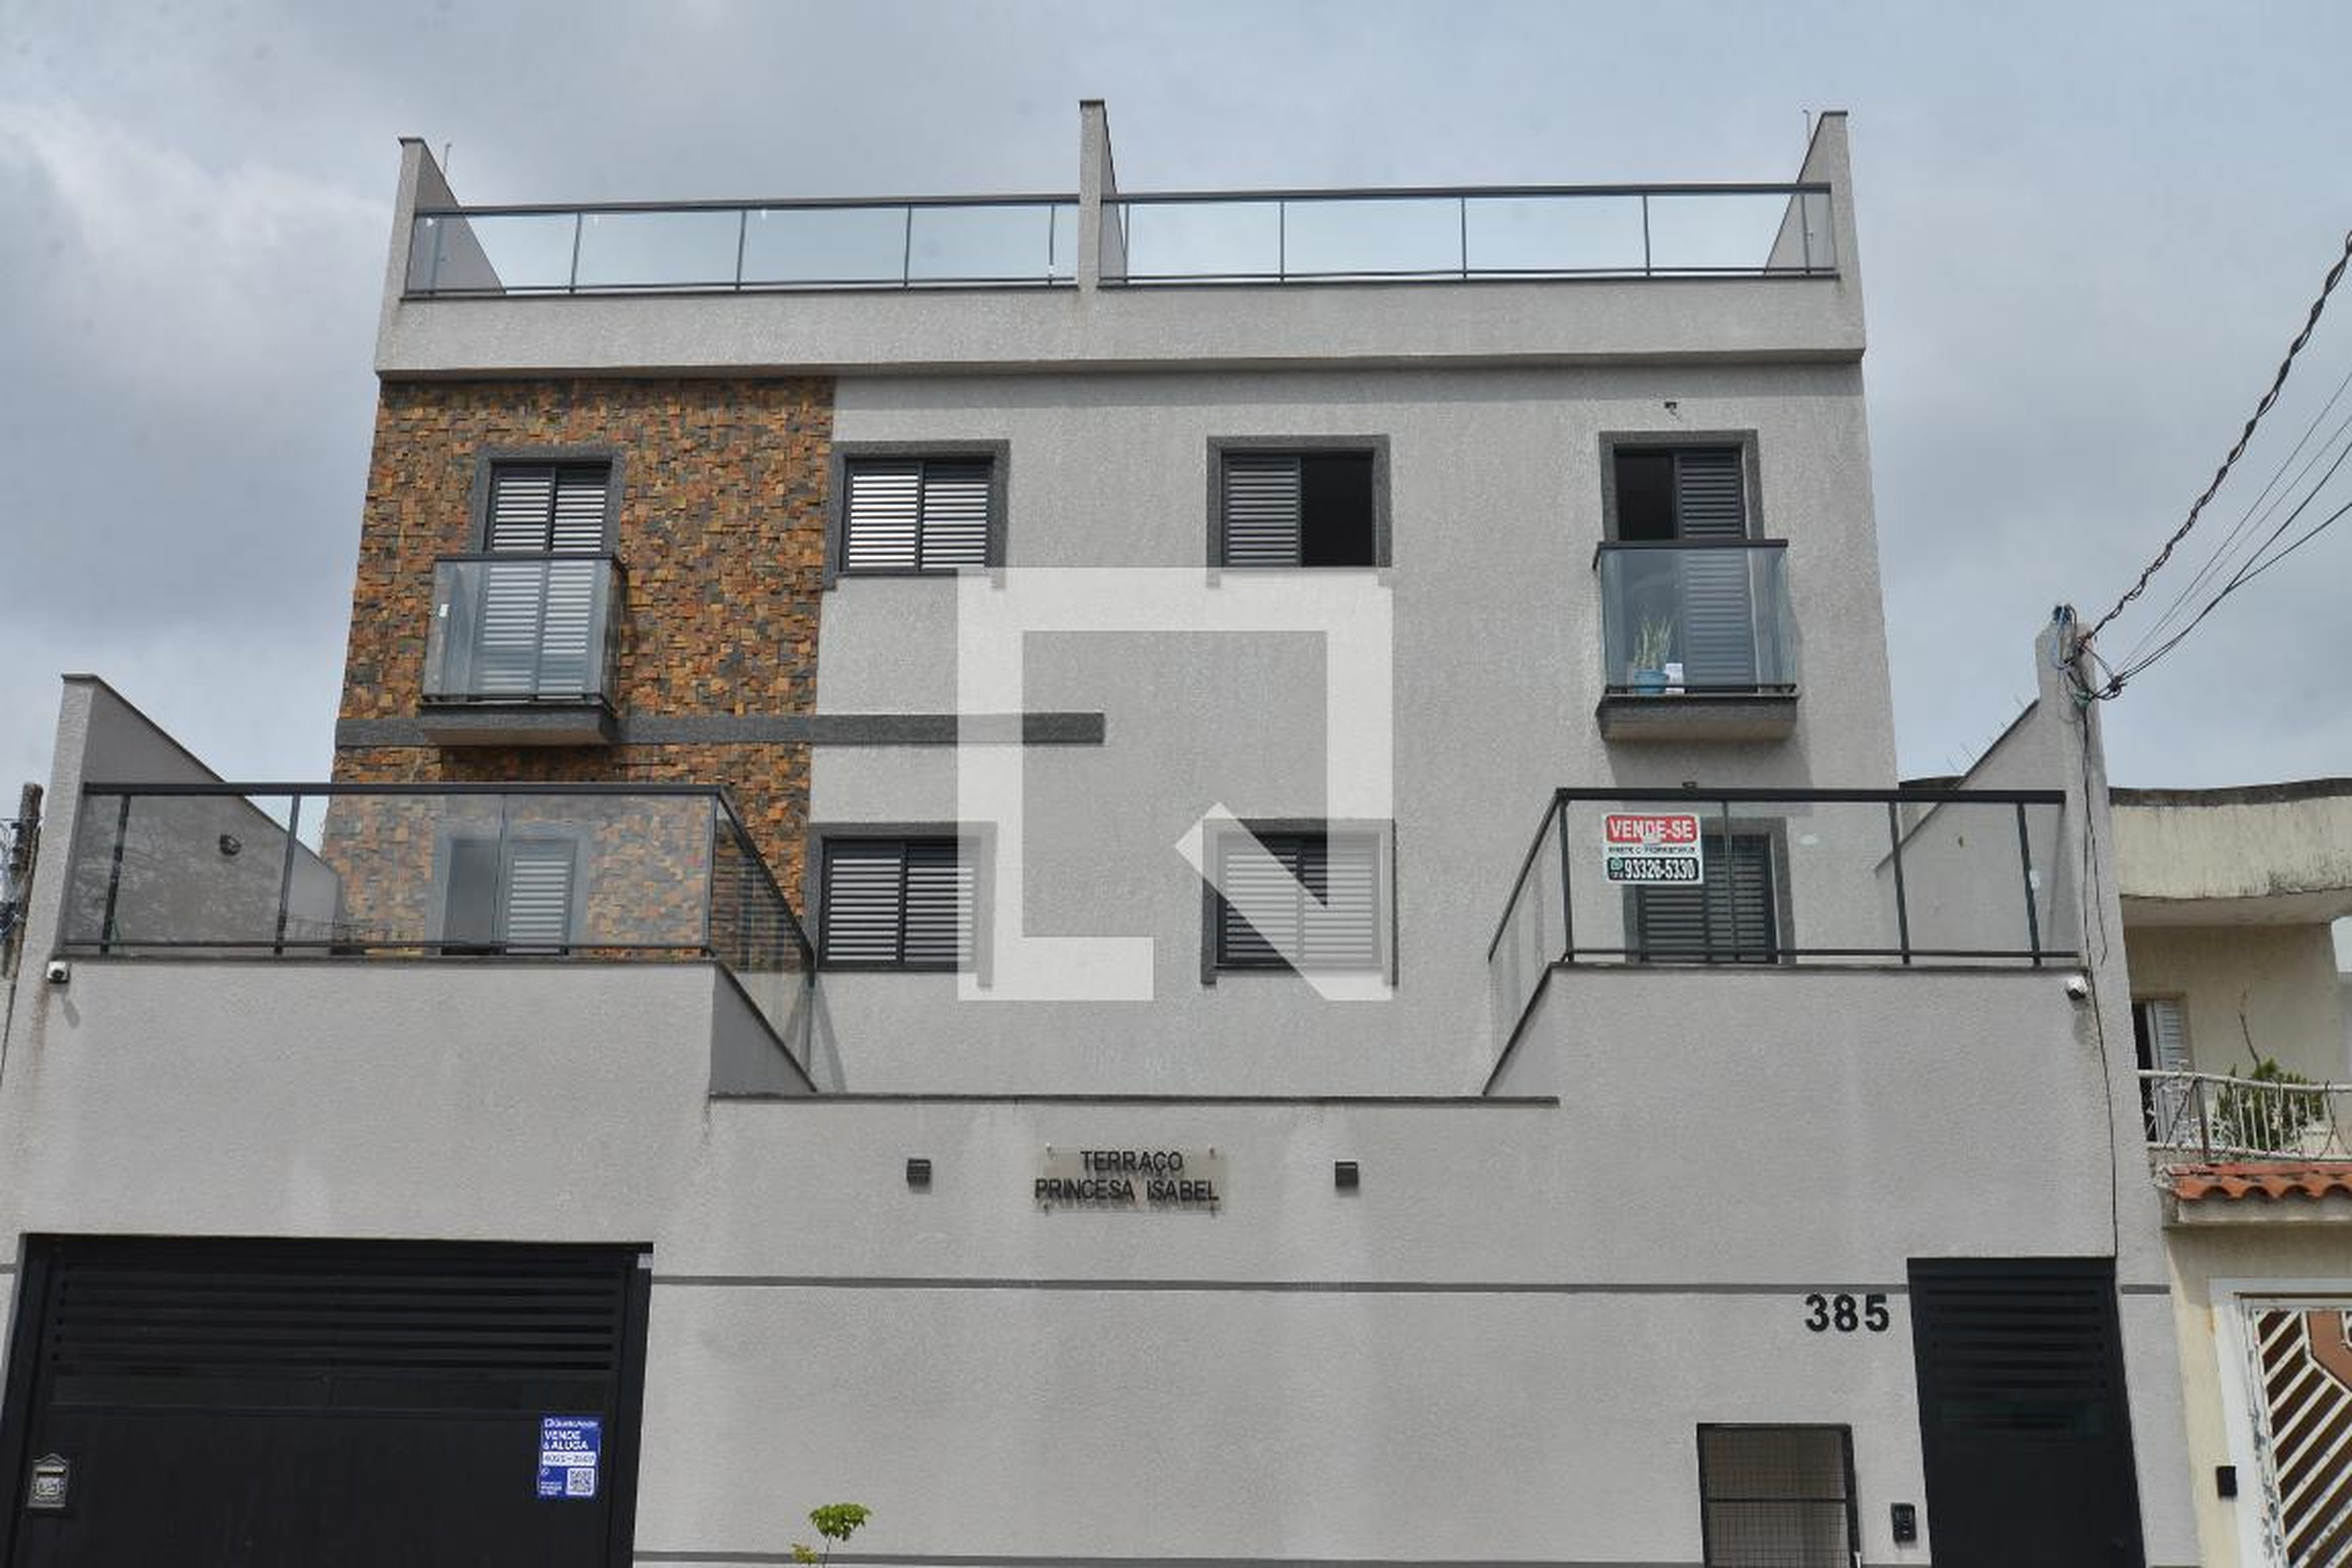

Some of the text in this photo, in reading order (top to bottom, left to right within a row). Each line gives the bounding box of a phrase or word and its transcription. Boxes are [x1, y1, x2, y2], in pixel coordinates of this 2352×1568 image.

[1610, 820, 1694, 839] VENDE-SE
[1080, 1150, 1183, 1176] TERRAÇO
[1035, 1178, 1219, 1201] PRINCESA ISABEL
[1806, 1294, 1890, 1332] 385
[544, 1430, 581, 1440] VENDE
[551, 1441, 589, 1450] ALUGA
